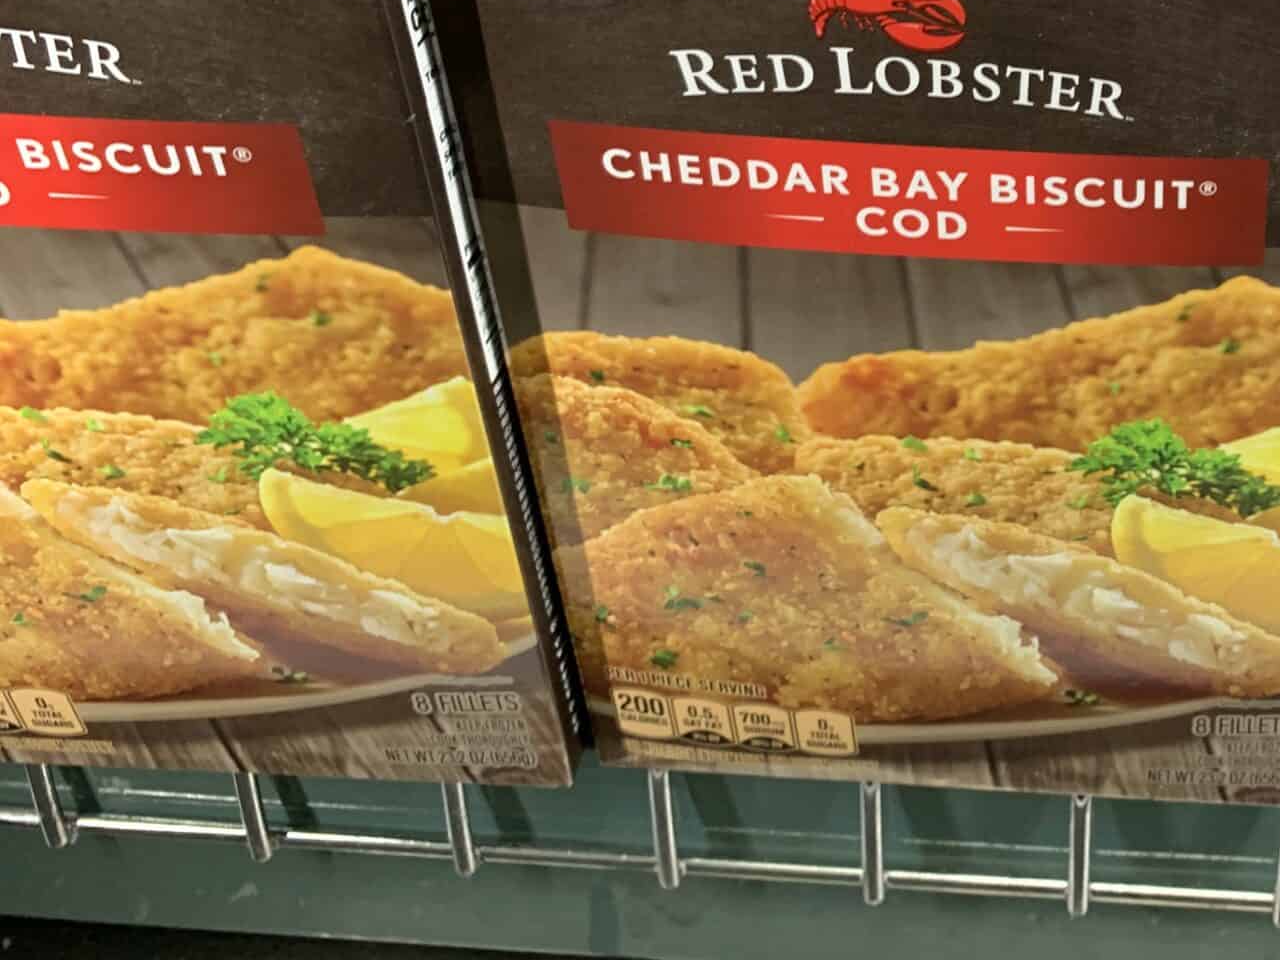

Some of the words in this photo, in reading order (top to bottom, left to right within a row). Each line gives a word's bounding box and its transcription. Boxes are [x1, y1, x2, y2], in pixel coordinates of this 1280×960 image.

[670, 48, 814, 98] RED
[829, 46, 1125, 121] LOBSTER
[601, 148, 848, 196] CHEDDAR
[871, 166, 969, 203] BAY
[856, 206, 968, 241] COD
[414, 694, 431, 712] 8
[436, 693, 521, 712] FILLETS
[618, 694, 665, 717] 200
[1194, 717, 1209, 735] 8
[385, 750, 408, 761] NET
[1148, 770, 1169, 782] NET
